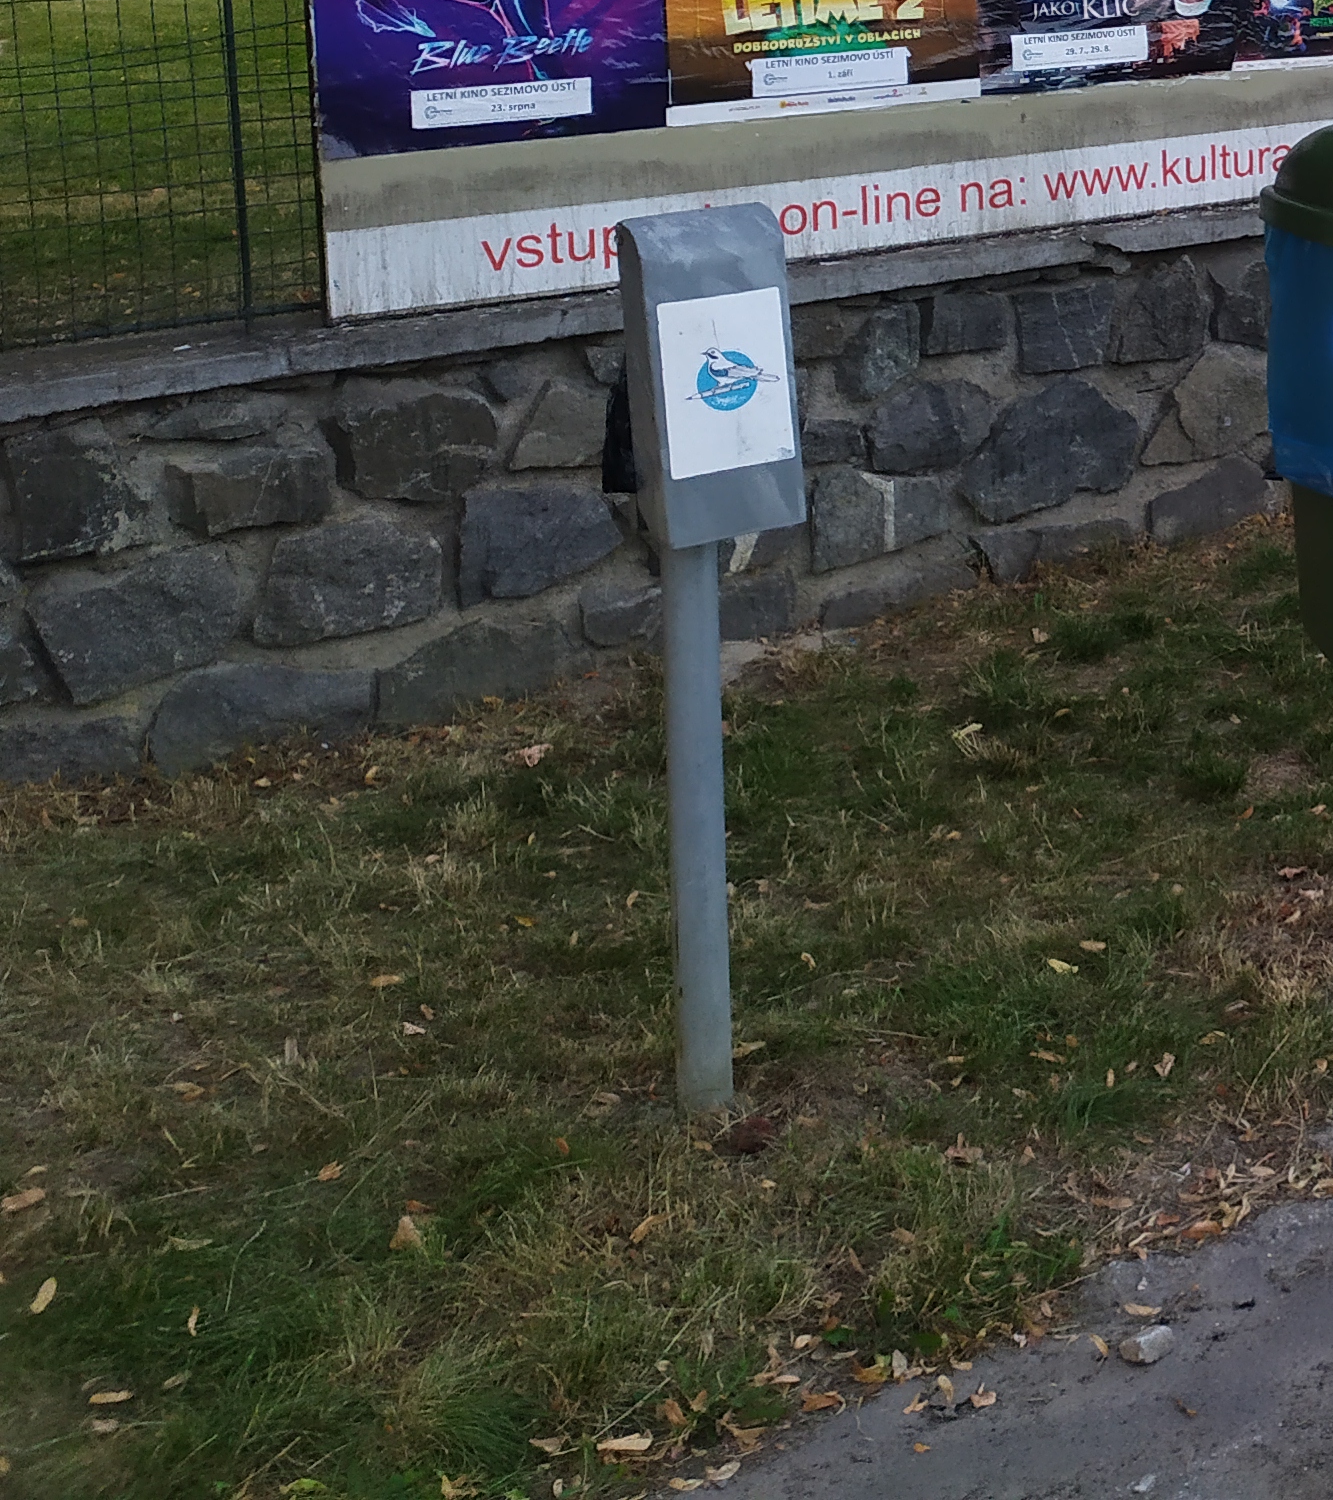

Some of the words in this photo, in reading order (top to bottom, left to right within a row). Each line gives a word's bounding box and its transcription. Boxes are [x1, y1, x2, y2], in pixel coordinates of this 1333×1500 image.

[1033, 0, 1076, 22] JAKO
[845, 34, 854, 44] V
[1023, 34, 1046, 45] LETNÍ
[1047, 33, 1069, 43] KINO
[1070, 29, 1115, 41] SEZIMOVO
[1117, 26, 1136, 38] ÚSTÍ
[409, 40, 492, 77] Blue
[493, 28, 594, 73] Beetle
[765, 56, 793, 70] LETNÍ
[795, 56, 819, 69] KINO
[821, 51, 871, 66] SEZIMOVO
[873, 49, 894, 61] ÚSTÍ
[1091, 45, 1104, 54] 29.
[828, 70, 837, 79] 1.
[426, 87, 458, 102] LETNÍ
[460, 87, 488, 100] KINO
[491, 83, 548, 97] SEZIMOVO
[551, 79, 576, 93] ÚSTÍ
[490, 103, 506, 113] 23.
[508, 102, 536, 113] srpna
[779, 184, 941, 236] on-line
[959, 175, 1027, 213] na:
